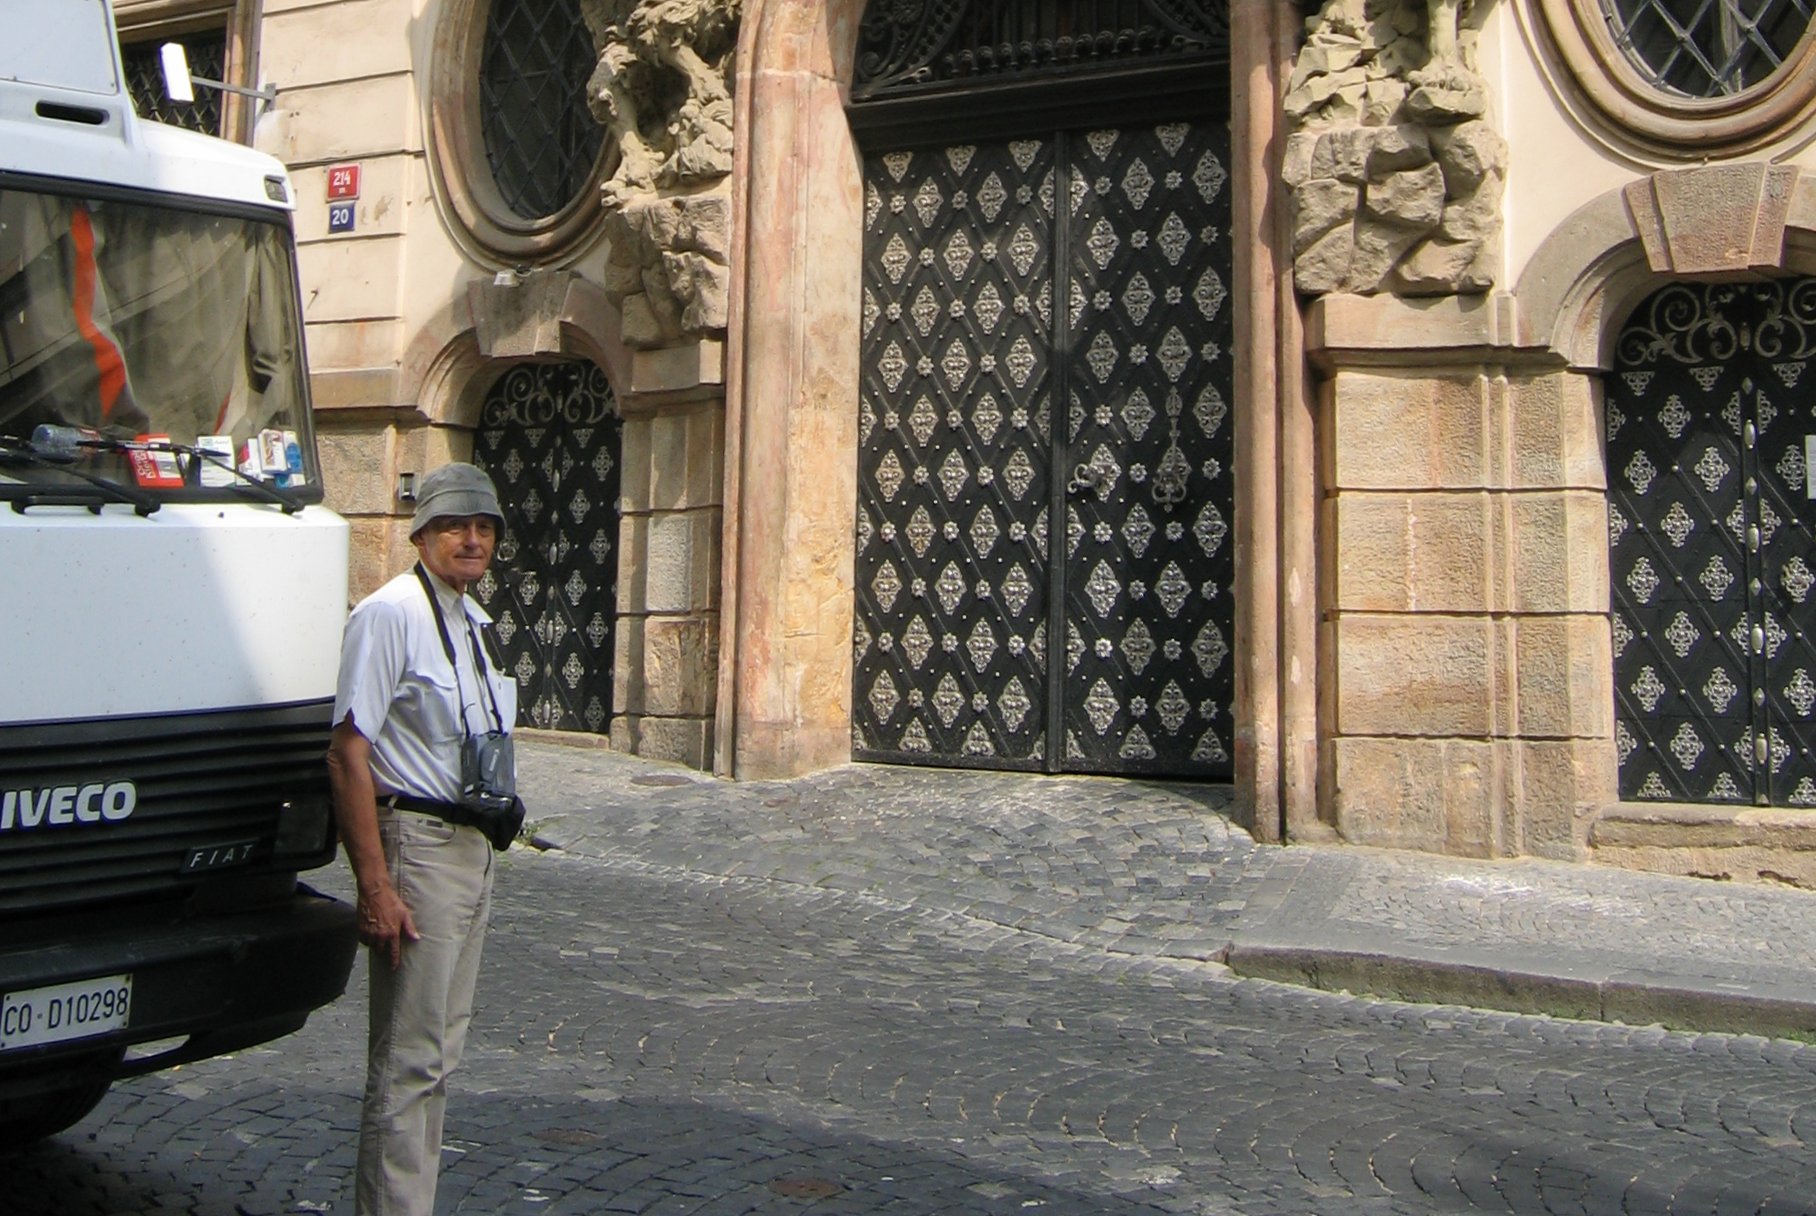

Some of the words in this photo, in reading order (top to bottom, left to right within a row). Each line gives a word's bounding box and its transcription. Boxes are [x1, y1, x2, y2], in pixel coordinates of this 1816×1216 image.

[332, 170, 351, 187] 214
[332, 208, 349, 225] 20
[0, 782, 137, 830] IVECO
[190, 844, 253, 868] FIAT
[4, 1003, 32, 1036] CO
[48, 987, 129, 1029] D10298
